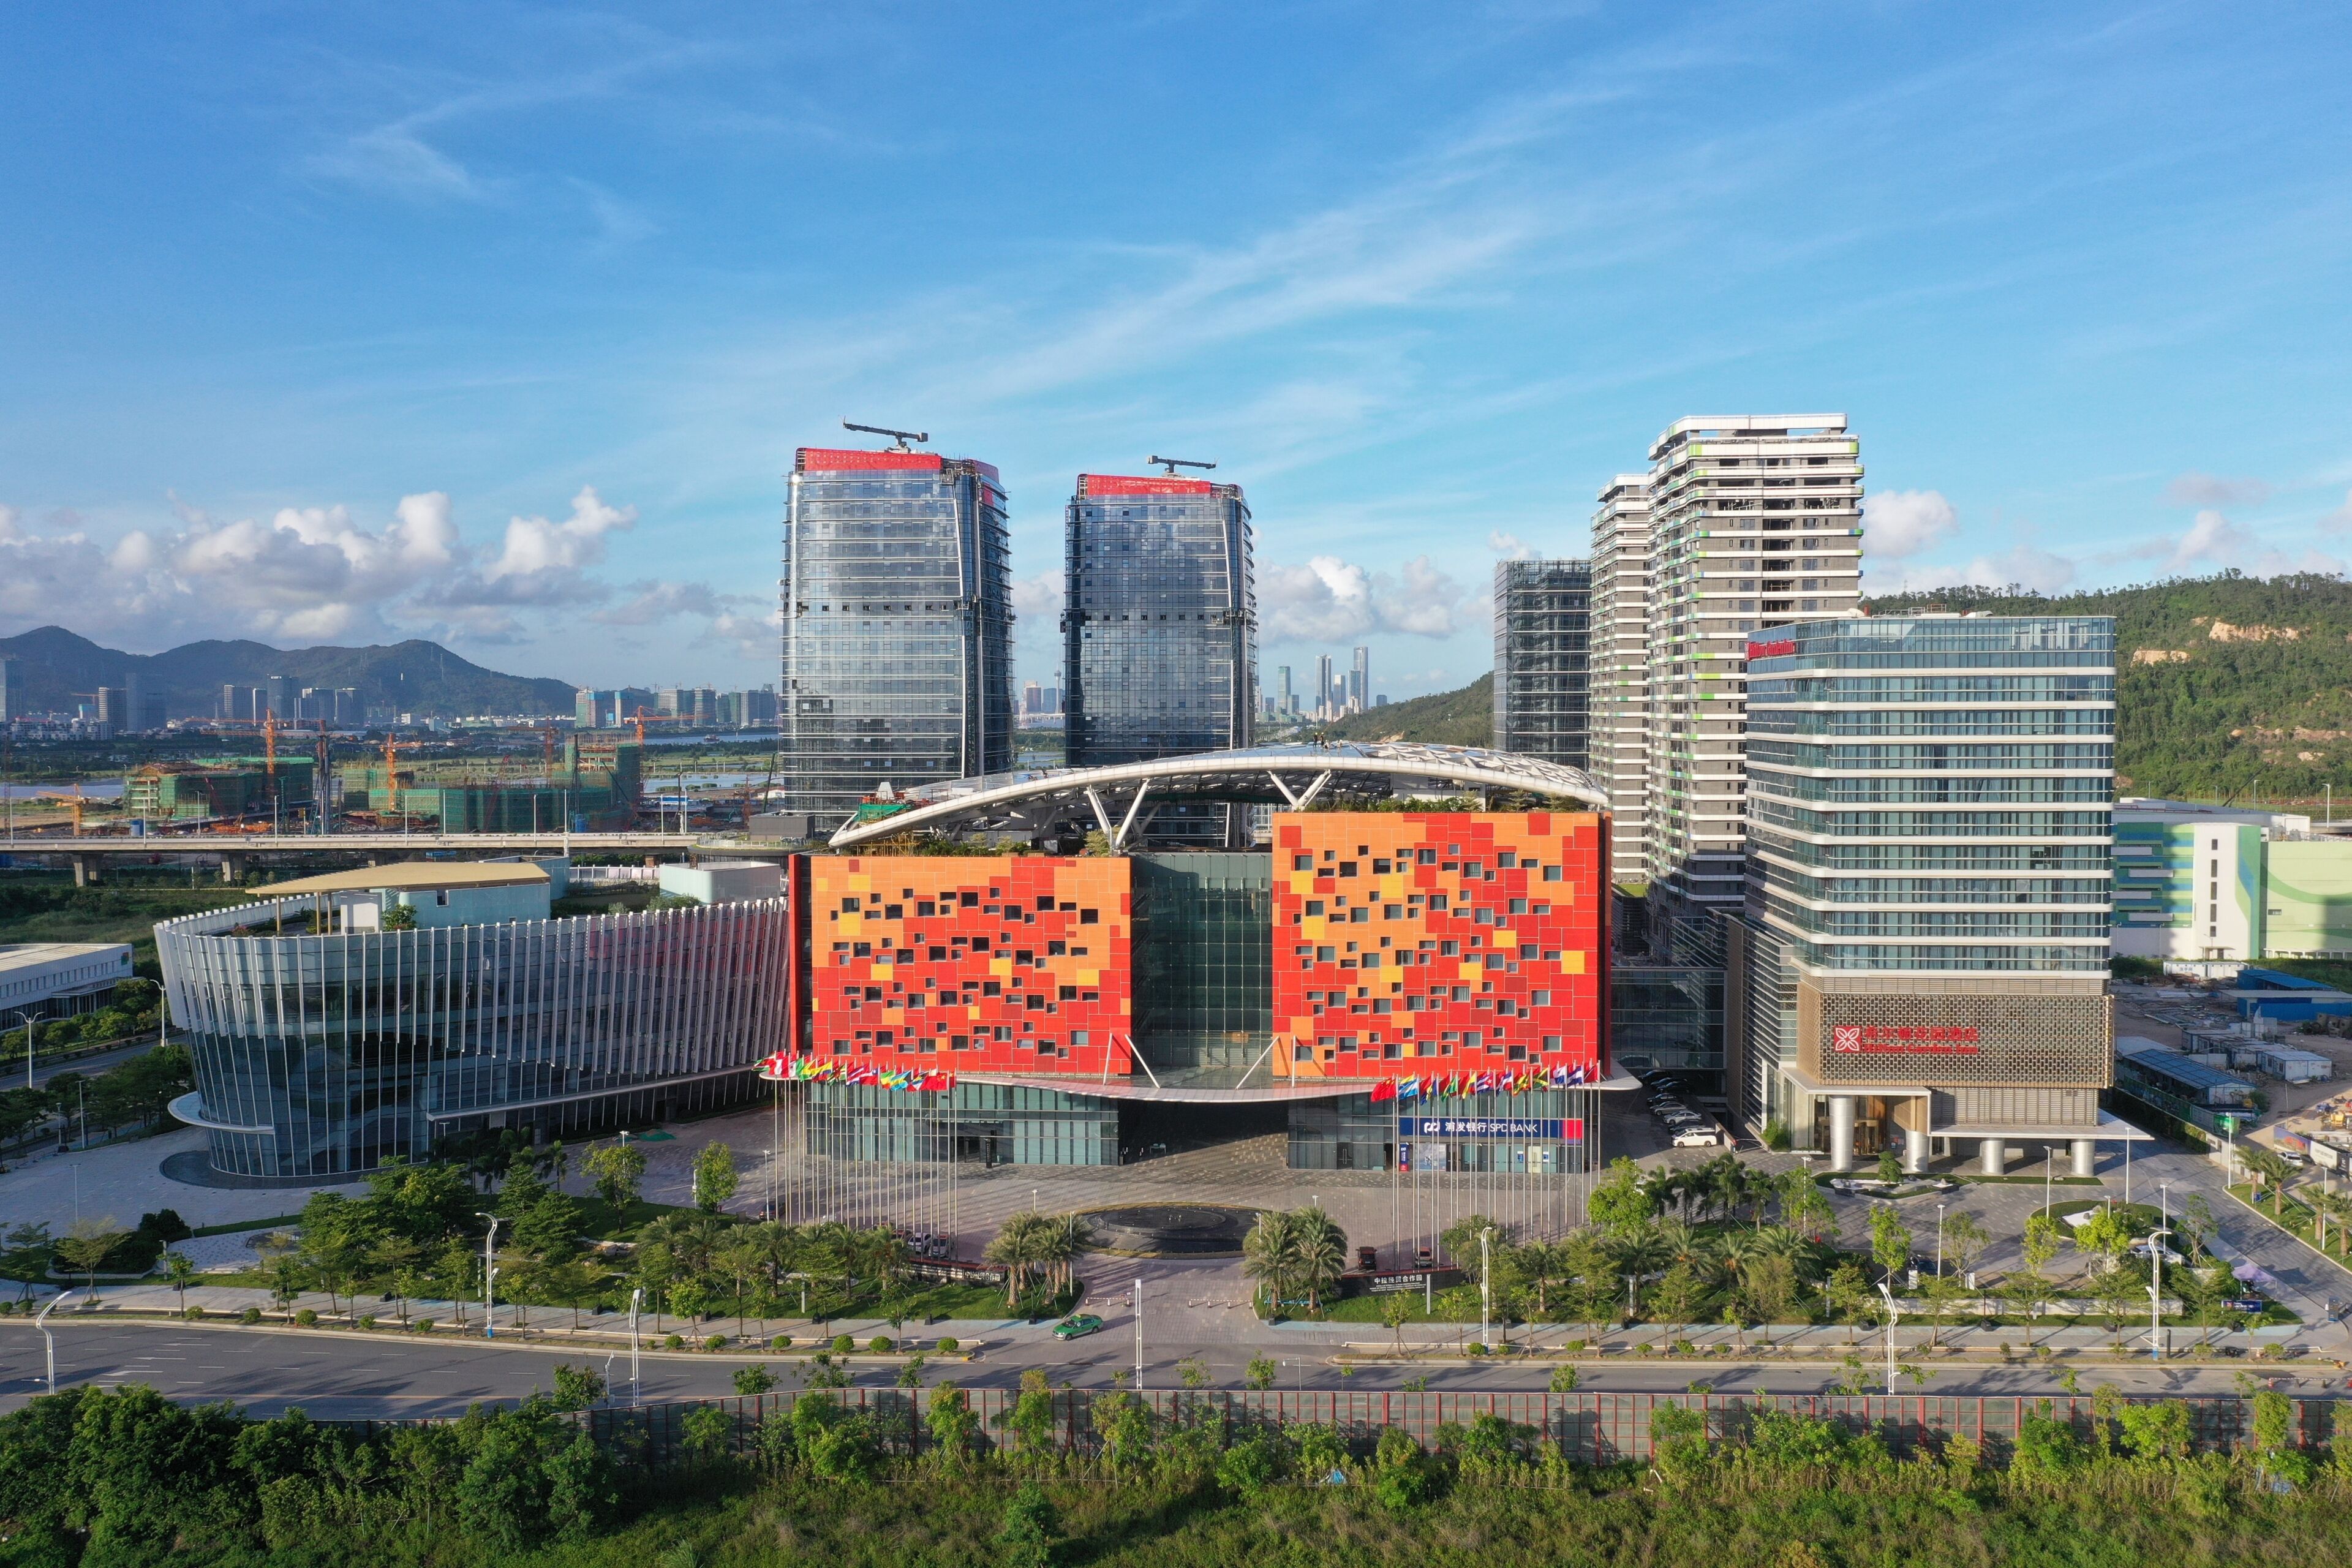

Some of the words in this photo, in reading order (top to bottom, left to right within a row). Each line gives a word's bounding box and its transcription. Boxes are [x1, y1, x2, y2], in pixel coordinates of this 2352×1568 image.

[1445, 1121, 1487, 1133] 浦发银行
[1490, 1123, 1507, 1133] SPD
[1510, 1123, 1538, 1133] BANK
[1374, 1274, 1423, 1284] 中拉经贸合作园
